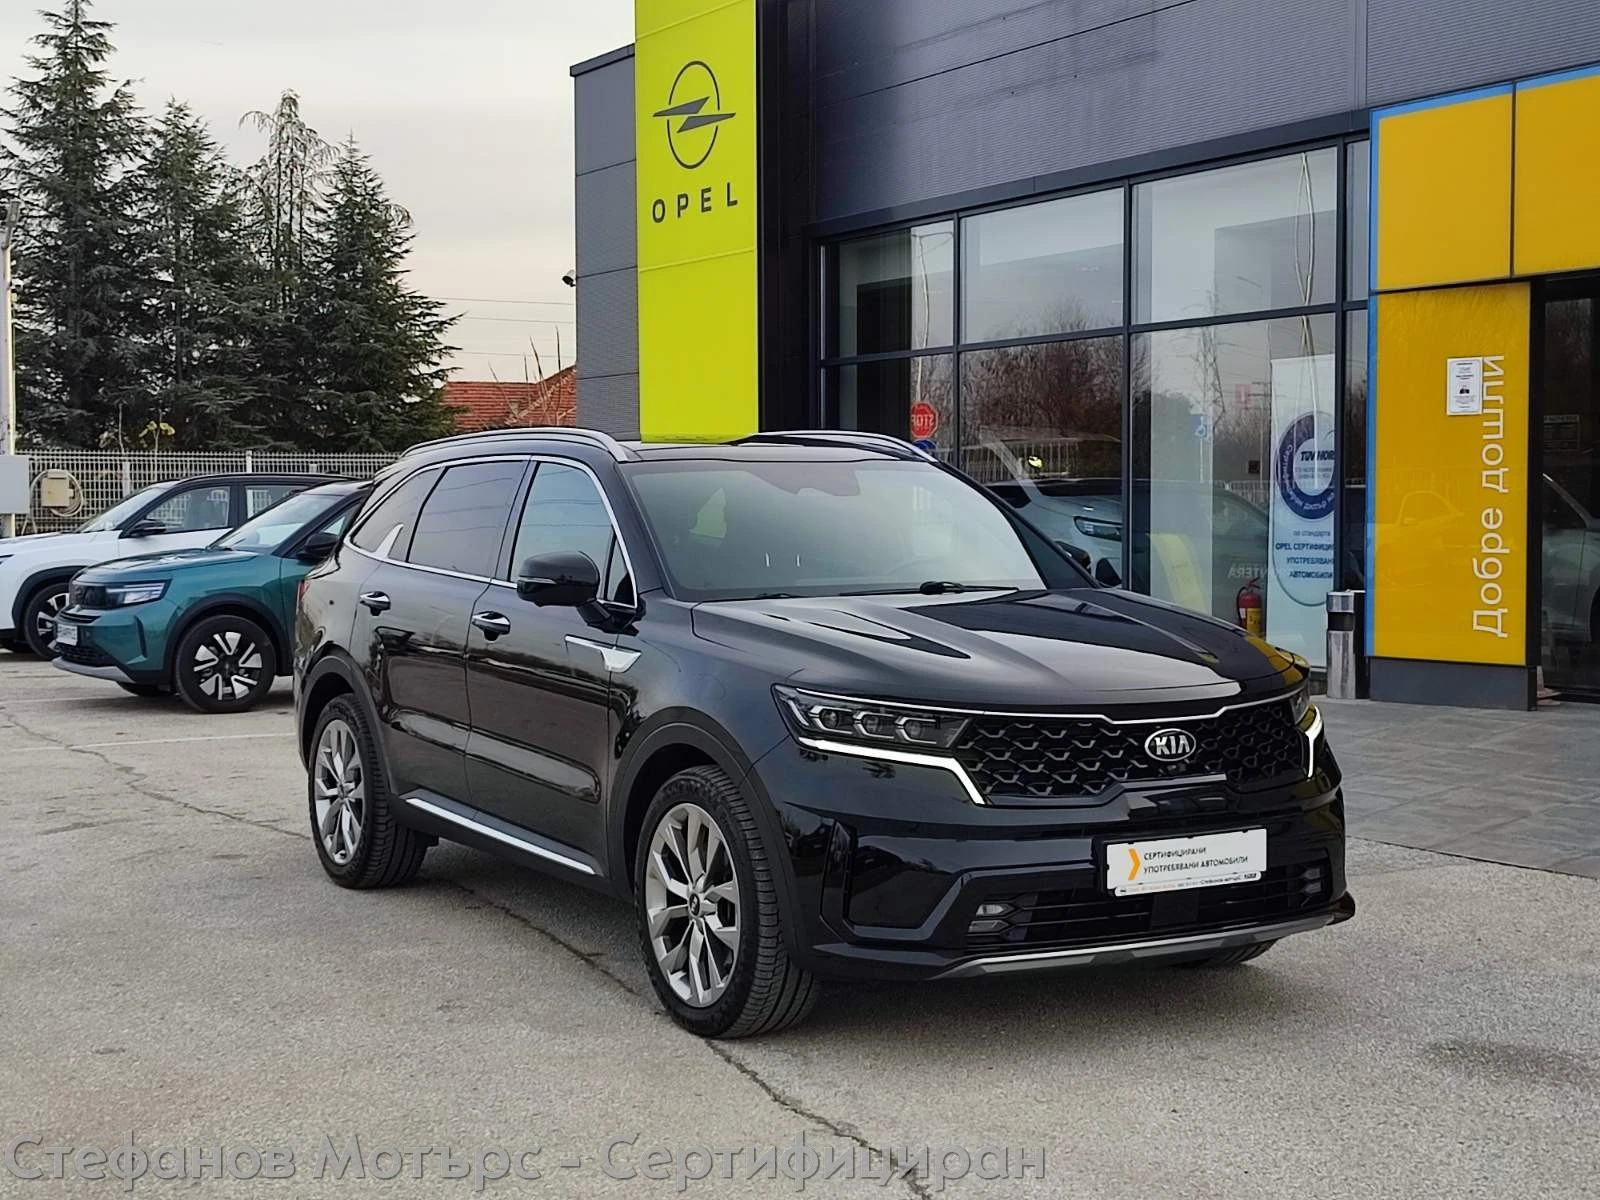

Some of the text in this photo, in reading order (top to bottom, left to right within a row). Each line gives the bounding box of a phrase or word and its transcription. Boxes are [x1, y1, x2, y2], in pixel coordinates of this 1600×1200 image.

[652, 182, 738, 223] OPEL
[1472, 355, 1510, 638] Добре дошли
[1275, 542, 1293, 551] OPEL
[1154, 735, 1191, 756] KIA
[1143, 847, 1207, 861] СЕРТИФИЦИРАНИ
[1143, 856, 1249, 875] УПОТРЕБЯВАНИ АВТОМОБИЛИ
